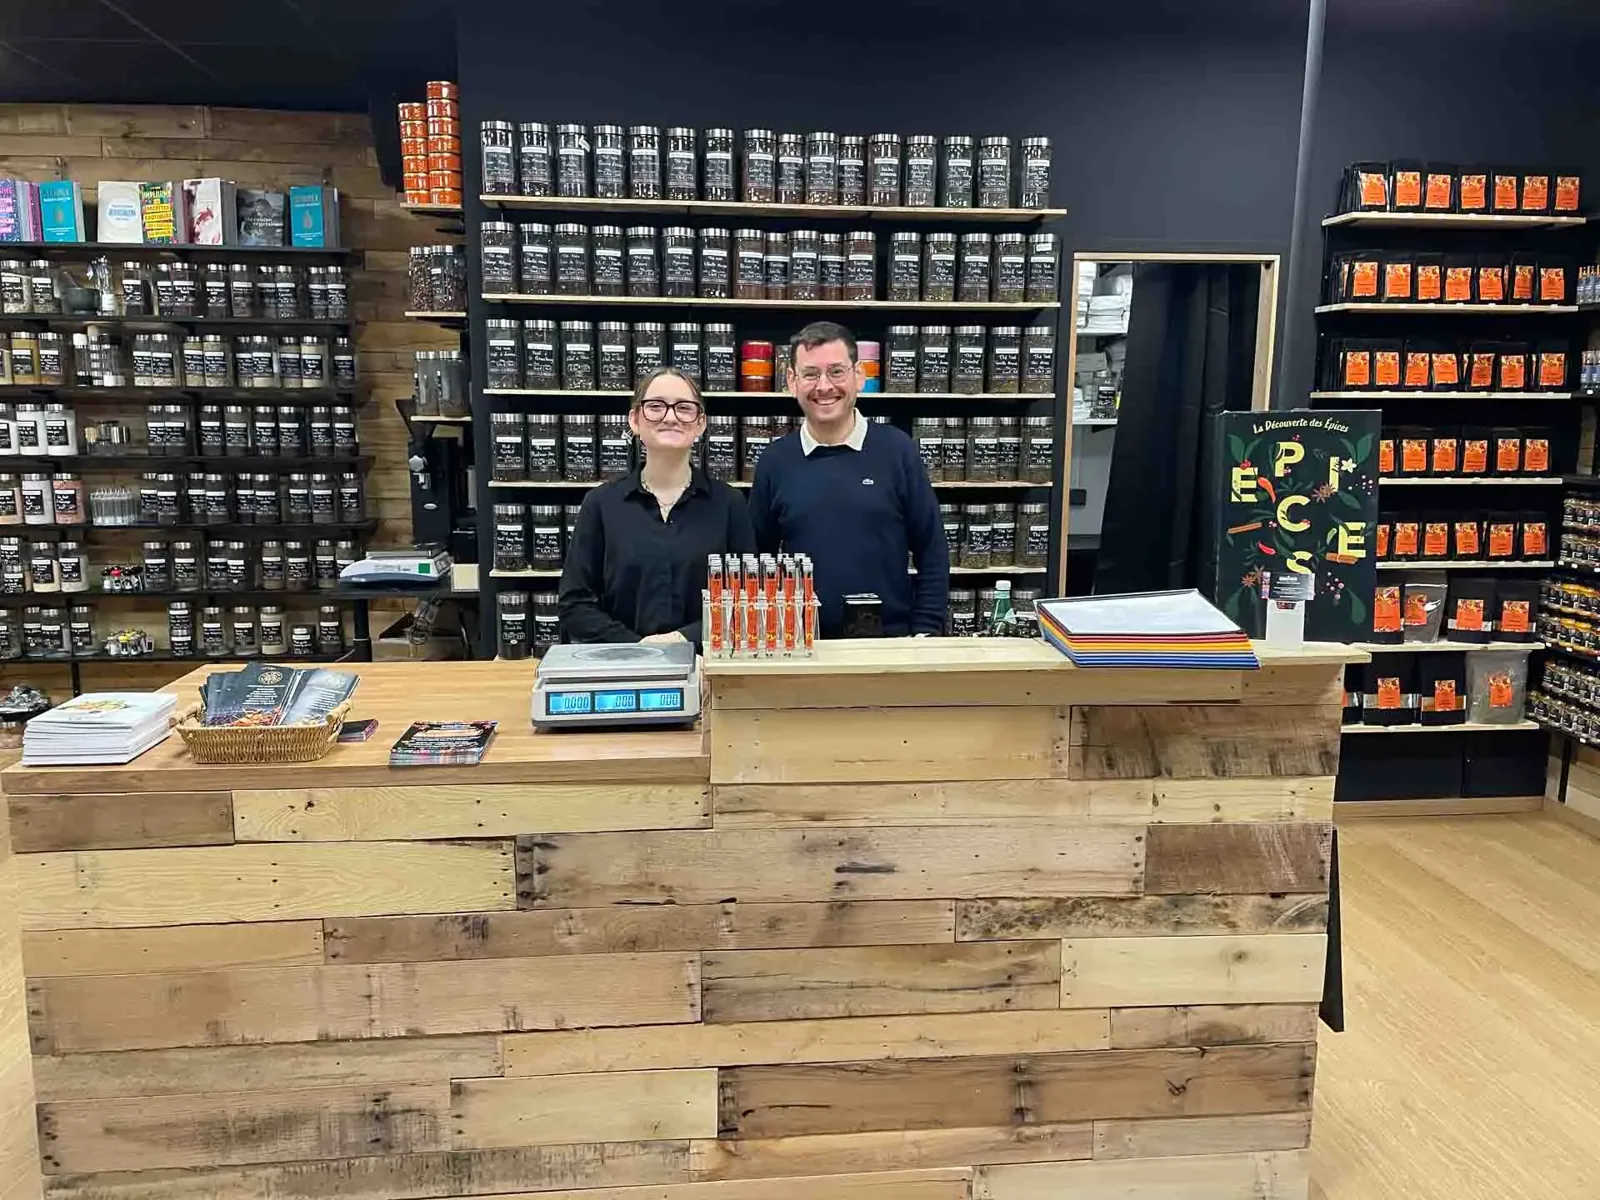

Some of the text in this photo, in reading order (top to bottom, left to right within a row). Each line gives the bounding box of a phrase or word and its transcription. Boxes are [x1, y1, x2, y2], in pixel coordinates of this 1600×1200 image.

[1253, 417, 1349, 434] La Découverte des Épices
